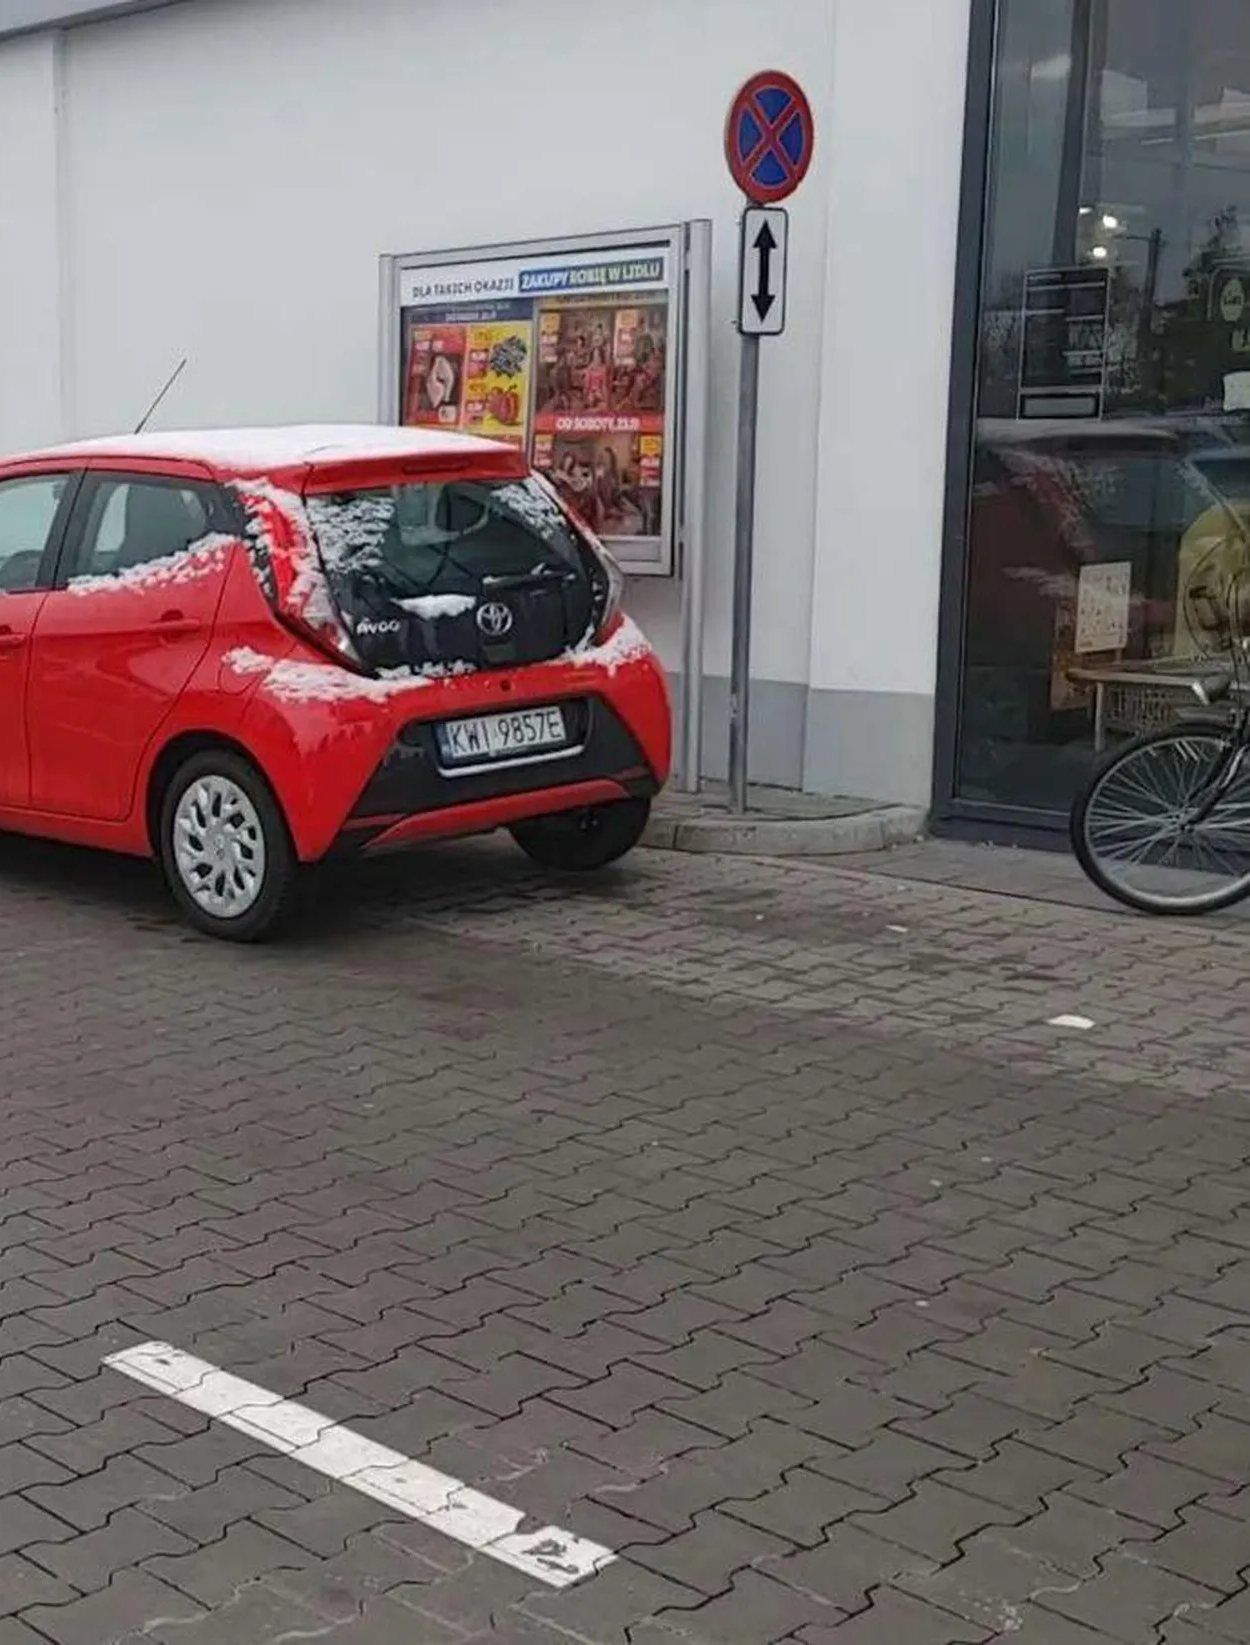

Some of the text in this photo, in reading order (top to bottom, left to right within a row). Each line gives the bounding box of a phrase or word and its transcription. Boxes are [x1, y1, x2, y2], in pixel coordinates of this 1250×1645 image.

[434, 281, 472, 295] TAKICH
[521, 269, 568, 290] ZAKUPY
[607, 264, 622, 282] W
[622, 261, 660, 281] LIDLU
[450, 710, 562, 753] KWI 9857E
